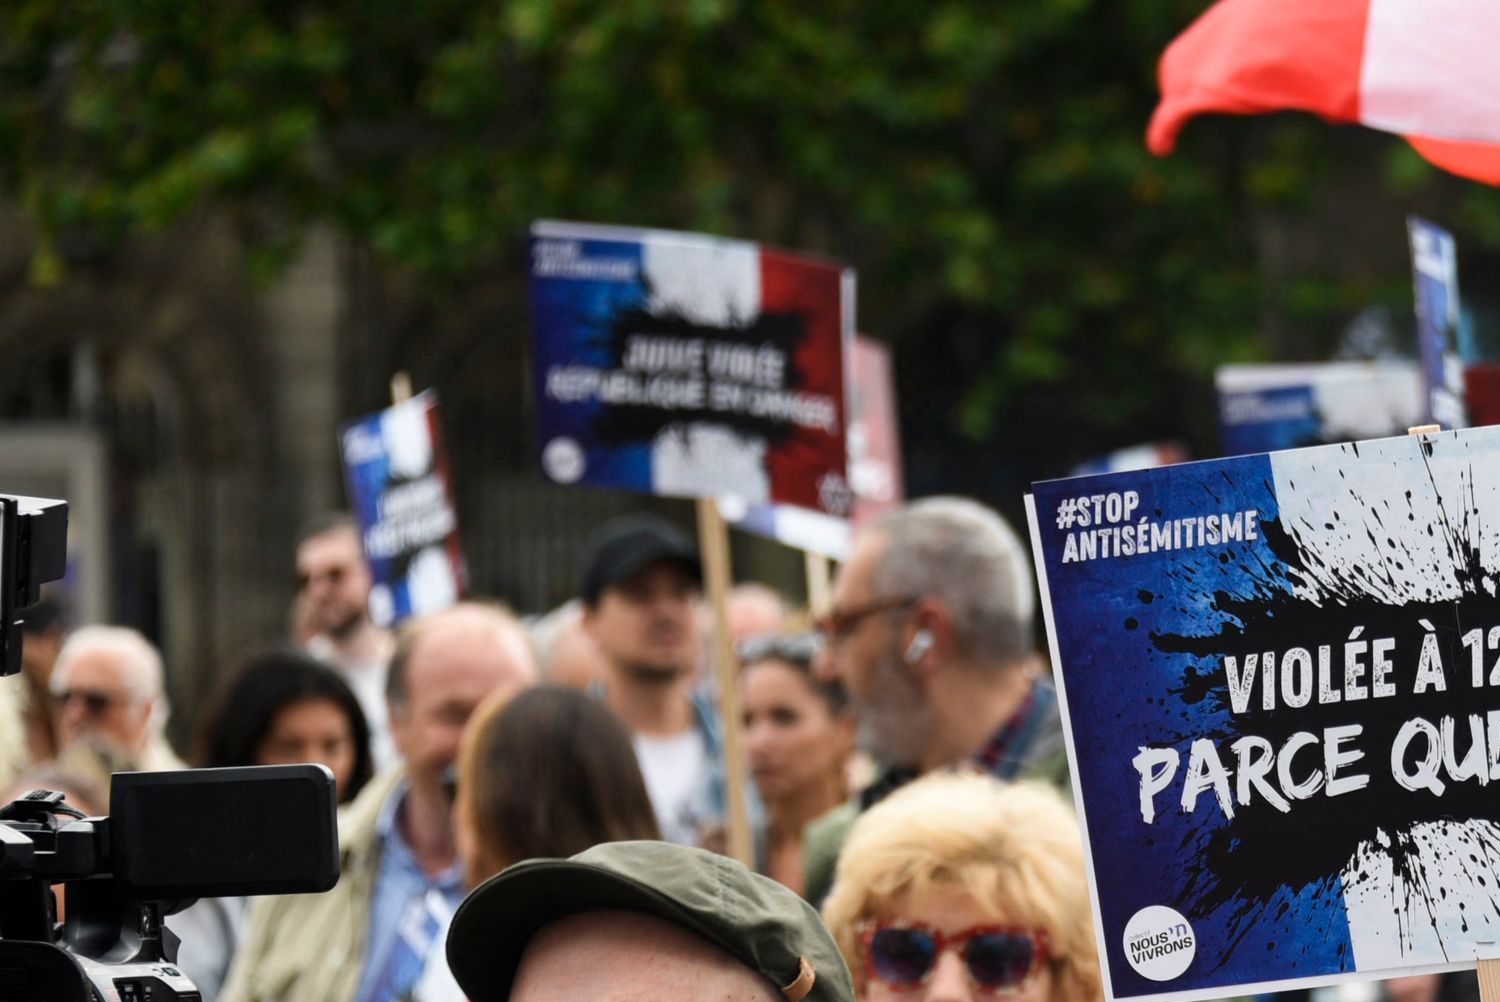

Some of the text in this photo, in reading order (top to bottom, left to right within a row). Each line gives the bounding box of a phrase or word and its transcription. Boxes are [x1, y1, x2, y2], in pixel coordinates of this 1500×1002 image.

[1056, 490, 1140, 529] #STOP
[1062, 510, 1258, 564] ANTISÉMITISME
[1223, 625, 1397, 714] VIOLÉE
[1413, 618, 1447, 694] À
[1131, 723, 1370, 824] PARCE
[1130, 932, 1169, 953] NOUS
[1132, 937, 1193, 964] VIVRONS
